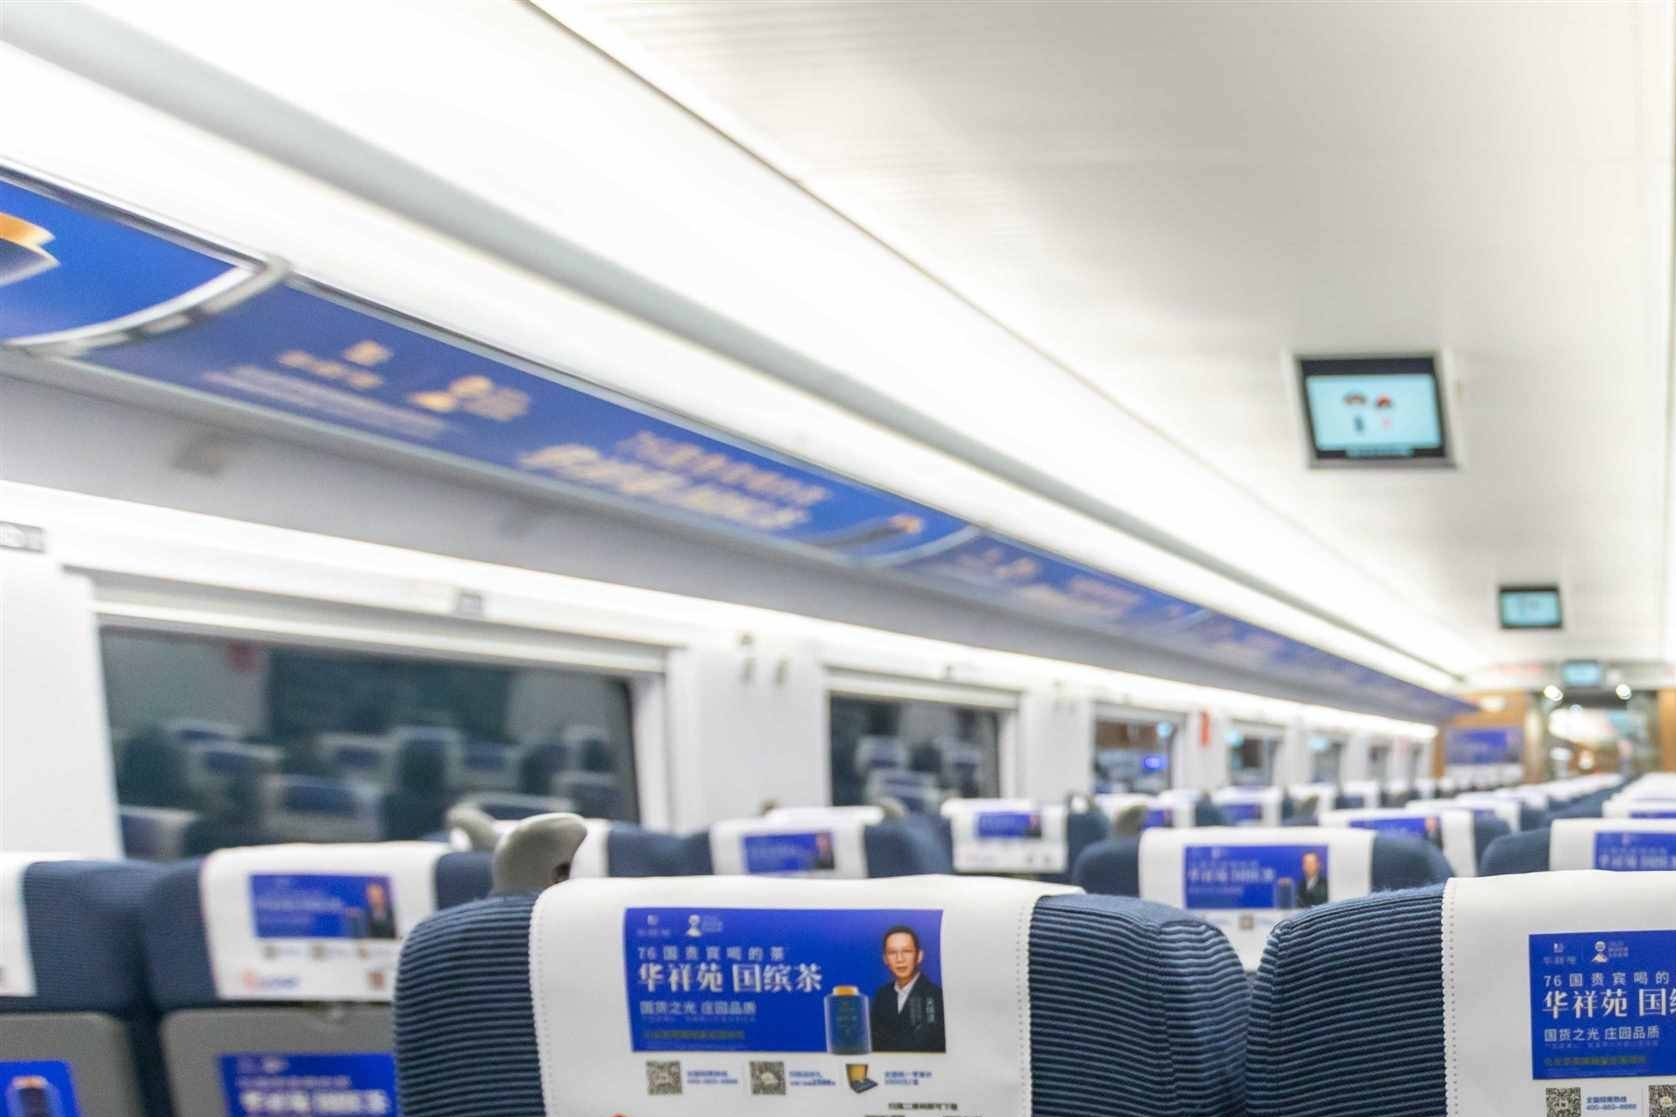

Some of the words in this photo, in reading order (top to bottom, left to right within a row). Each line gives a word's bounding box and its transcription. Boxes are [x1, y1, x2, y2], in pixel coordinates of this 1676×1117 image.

[638, 963, 724, 993] 华祥苑
[1542, 988, 1628, 1020] 华祥苑
